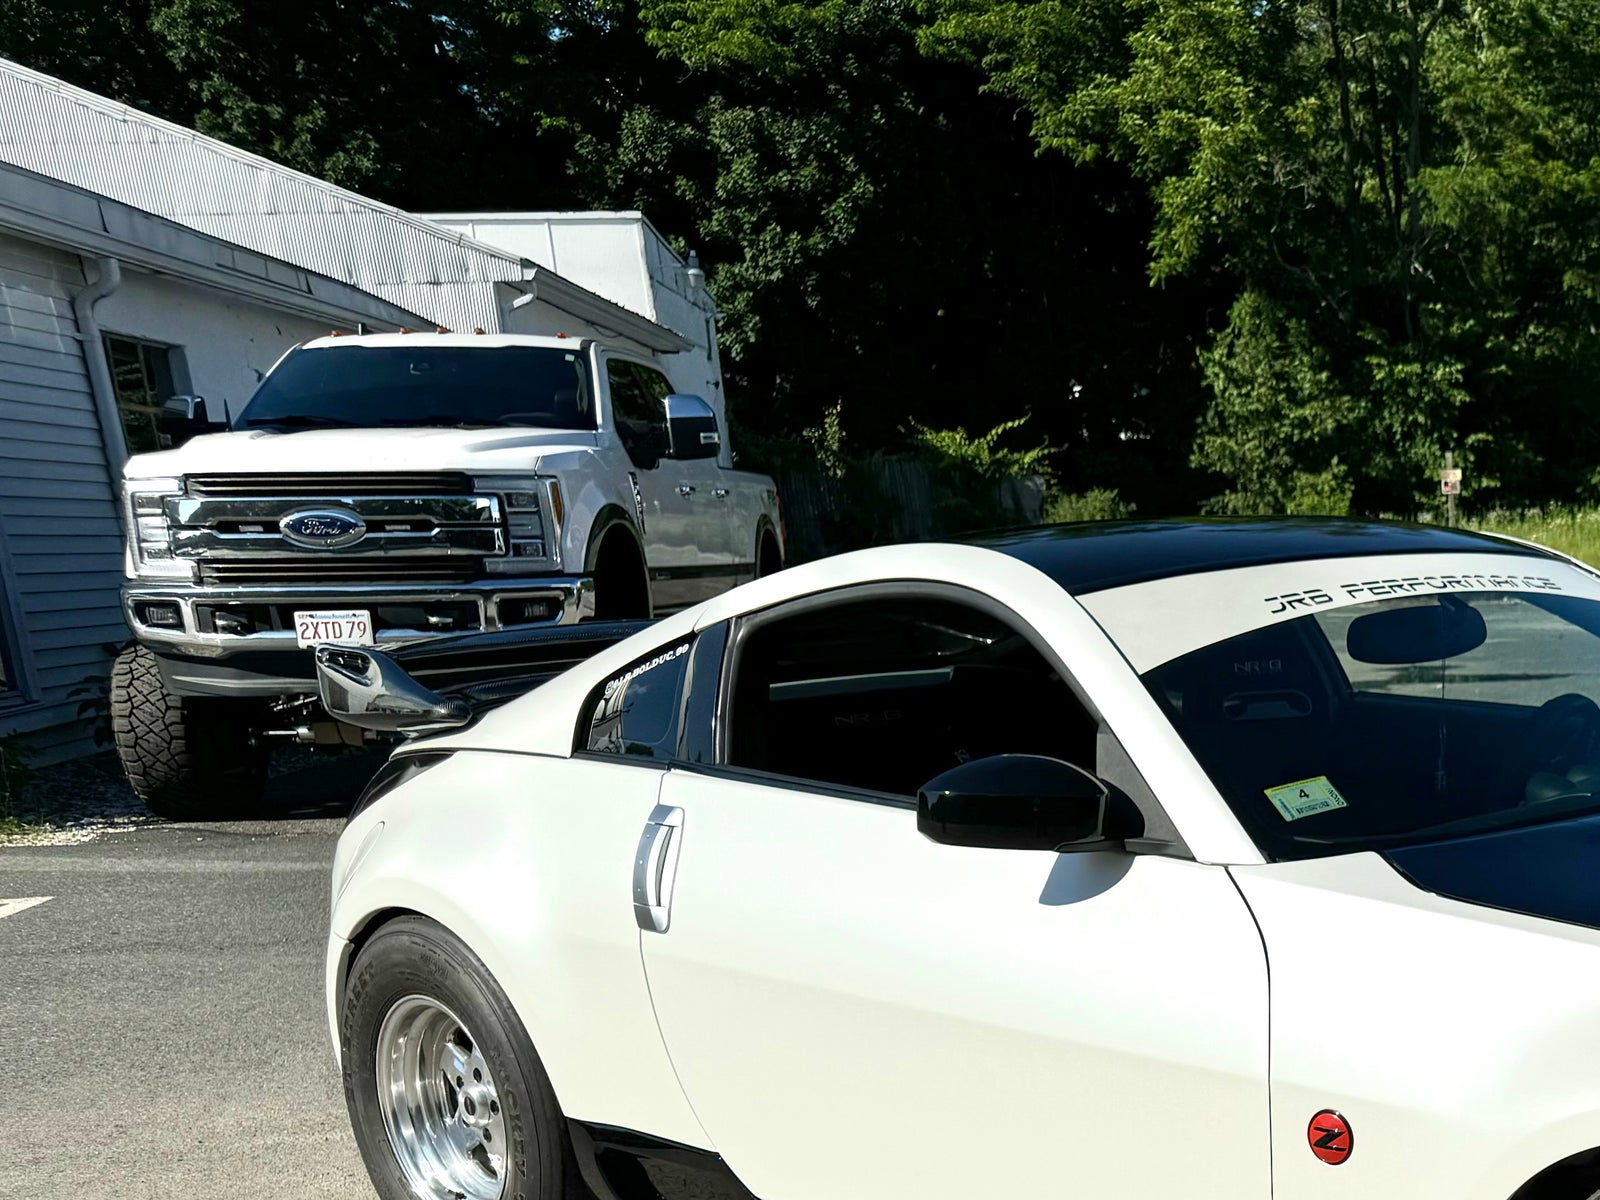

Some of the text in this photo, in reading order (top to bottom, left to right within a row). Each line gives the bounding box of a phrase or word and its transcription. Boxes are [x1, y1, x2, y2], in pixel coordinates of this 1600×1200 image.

[1264, 575, 1562, 614] JRB PERFORMANCE
[300, 621, 367, 640] 2XTD 79
